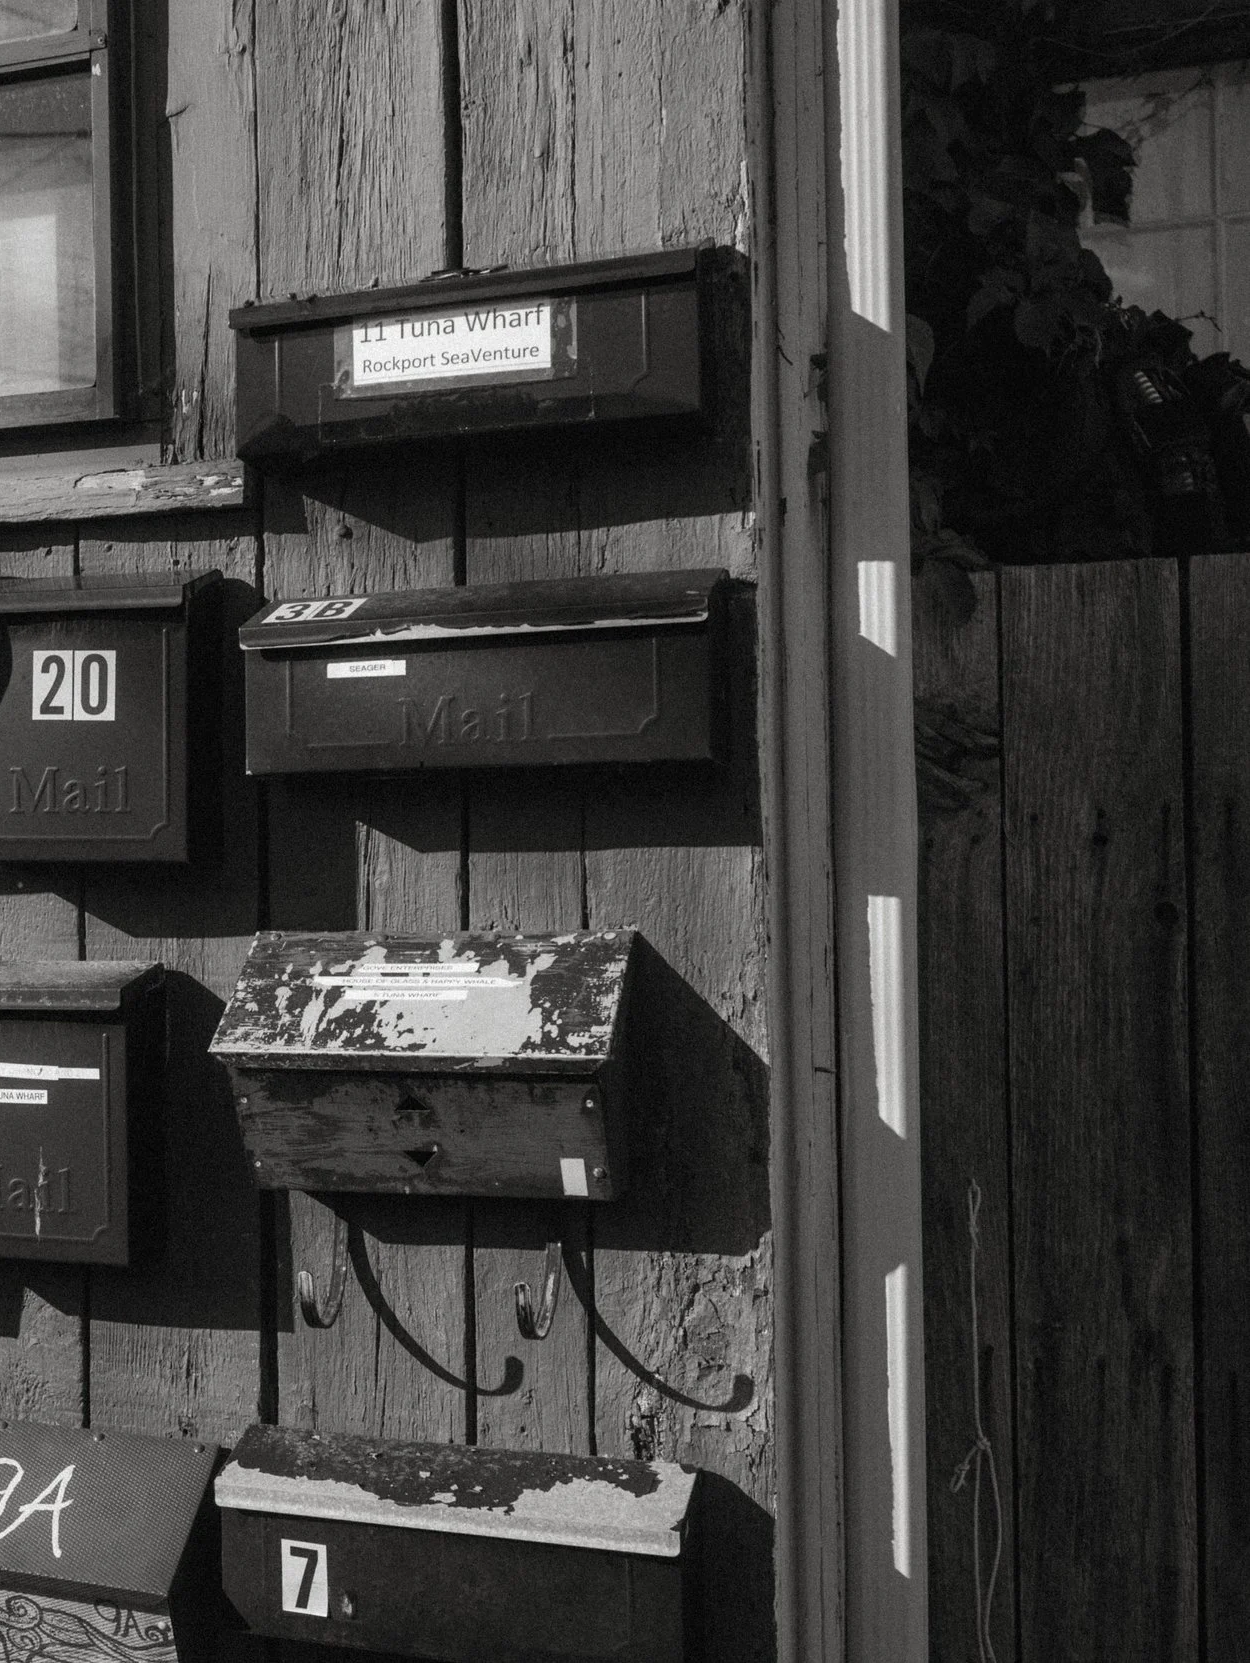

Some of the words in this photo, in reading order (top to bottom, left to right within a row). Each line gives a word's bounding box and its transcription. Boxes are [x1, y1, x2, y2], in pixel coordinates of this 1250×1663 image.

[359, 320, 388, 344] 11
[395, 315, 455, 340] Tuna
[463, 303, 546, 333] Wharf
[362, 352, 436, 375] Rockport
[440, 344, 540, 367] SeaVenture
[275, 600, 354, 622] 3B
[39, 653, 109, 716] 20
[349, 663, 386, 673] SEAGER
[398, 691, 534, 748] Mail
[8, 764, 132, 815] Mail
[430, 978, 461, 986] HAPPY
[463, 978, 496, 986] WHALE
[15, 1092, 45, 1101] WHARF
[289, 1545, 319, 1609] 7
